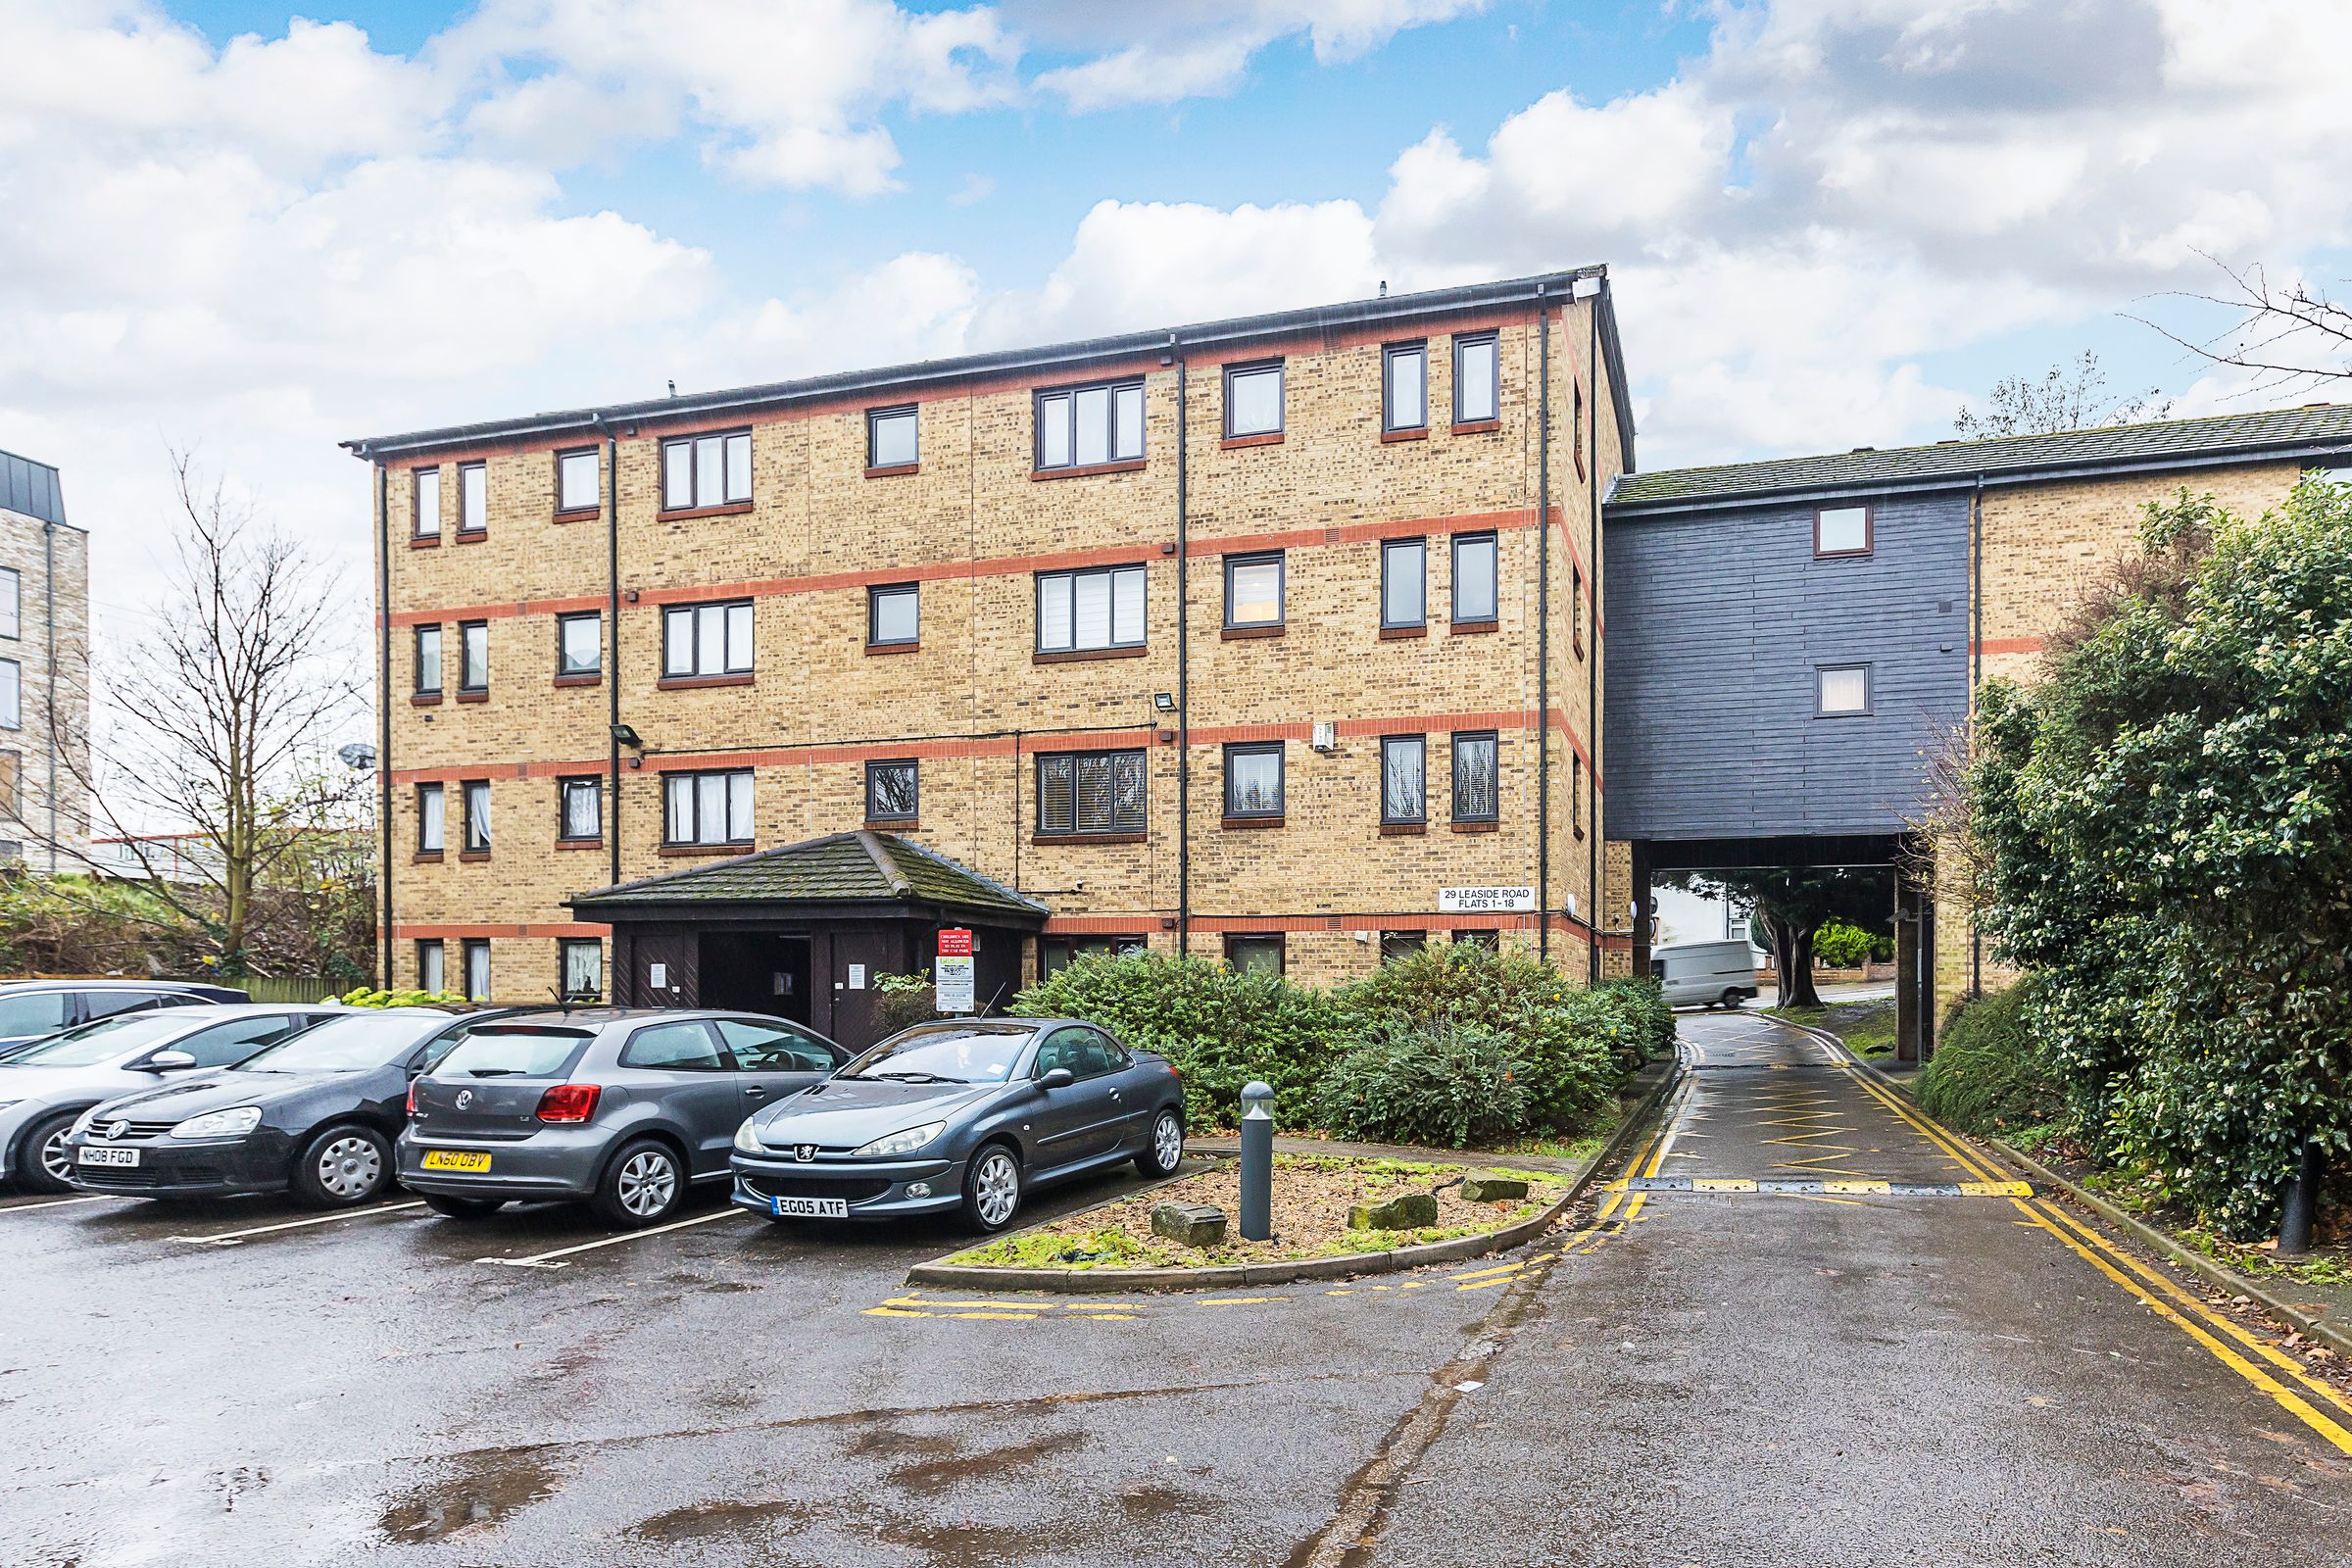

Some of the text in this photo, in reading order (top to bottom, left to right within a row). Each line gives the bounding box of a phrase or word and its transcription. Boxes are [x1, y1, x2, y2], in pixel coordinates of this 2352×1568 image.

[1445, 889, 1530, 899] 29 LEASIDE ROAD
[1458, 899, 1489, 908] FLATS
[82, 1150, 133, 1163] NH08 FGD
[429, 1152, 460, 1165] LN60
[780, 1199, 844, 1215] EG05 ATF
